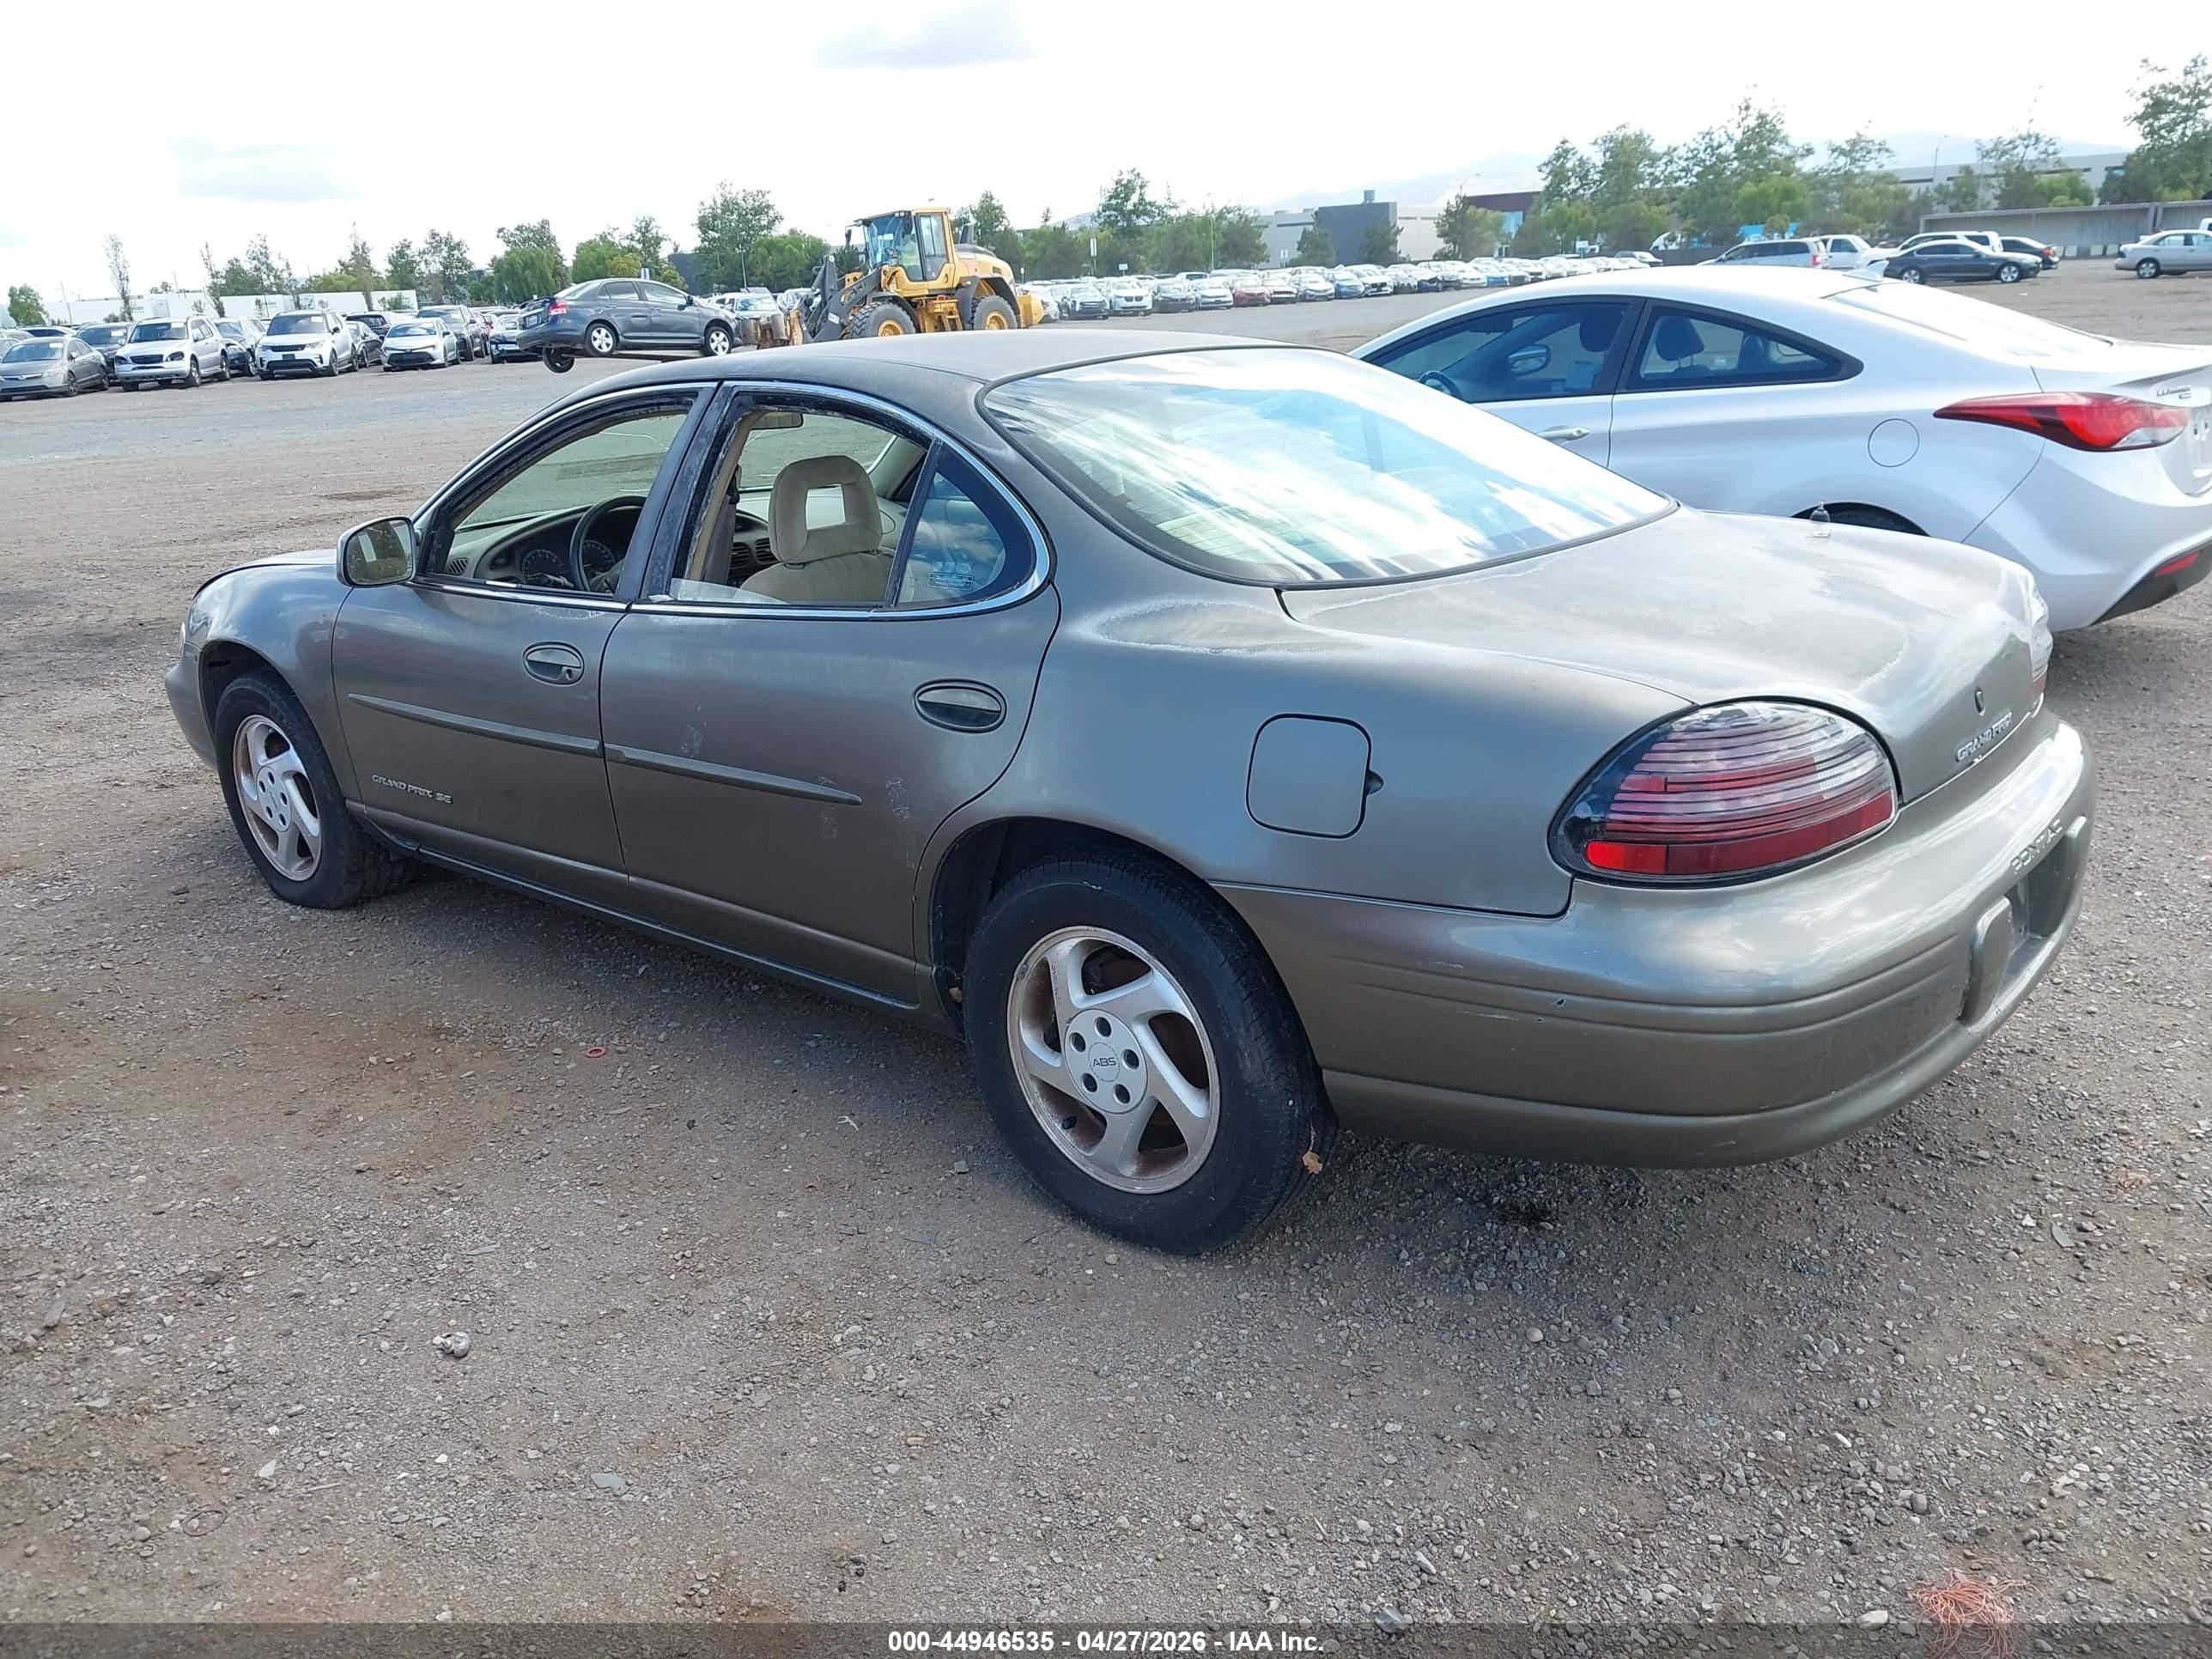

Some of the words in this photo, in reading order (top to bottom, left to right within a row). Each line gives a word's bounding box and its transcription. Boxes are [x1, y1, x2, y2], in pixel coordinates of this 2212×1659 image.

[1957, 727, 1992, 762] GRAND
[372, 775, 407, 790] GRAND
[407, 784, 434, 799] PRIX
[435, 792, 453, 804] SE
[1092, 1057, 1117, 1067] ABS
